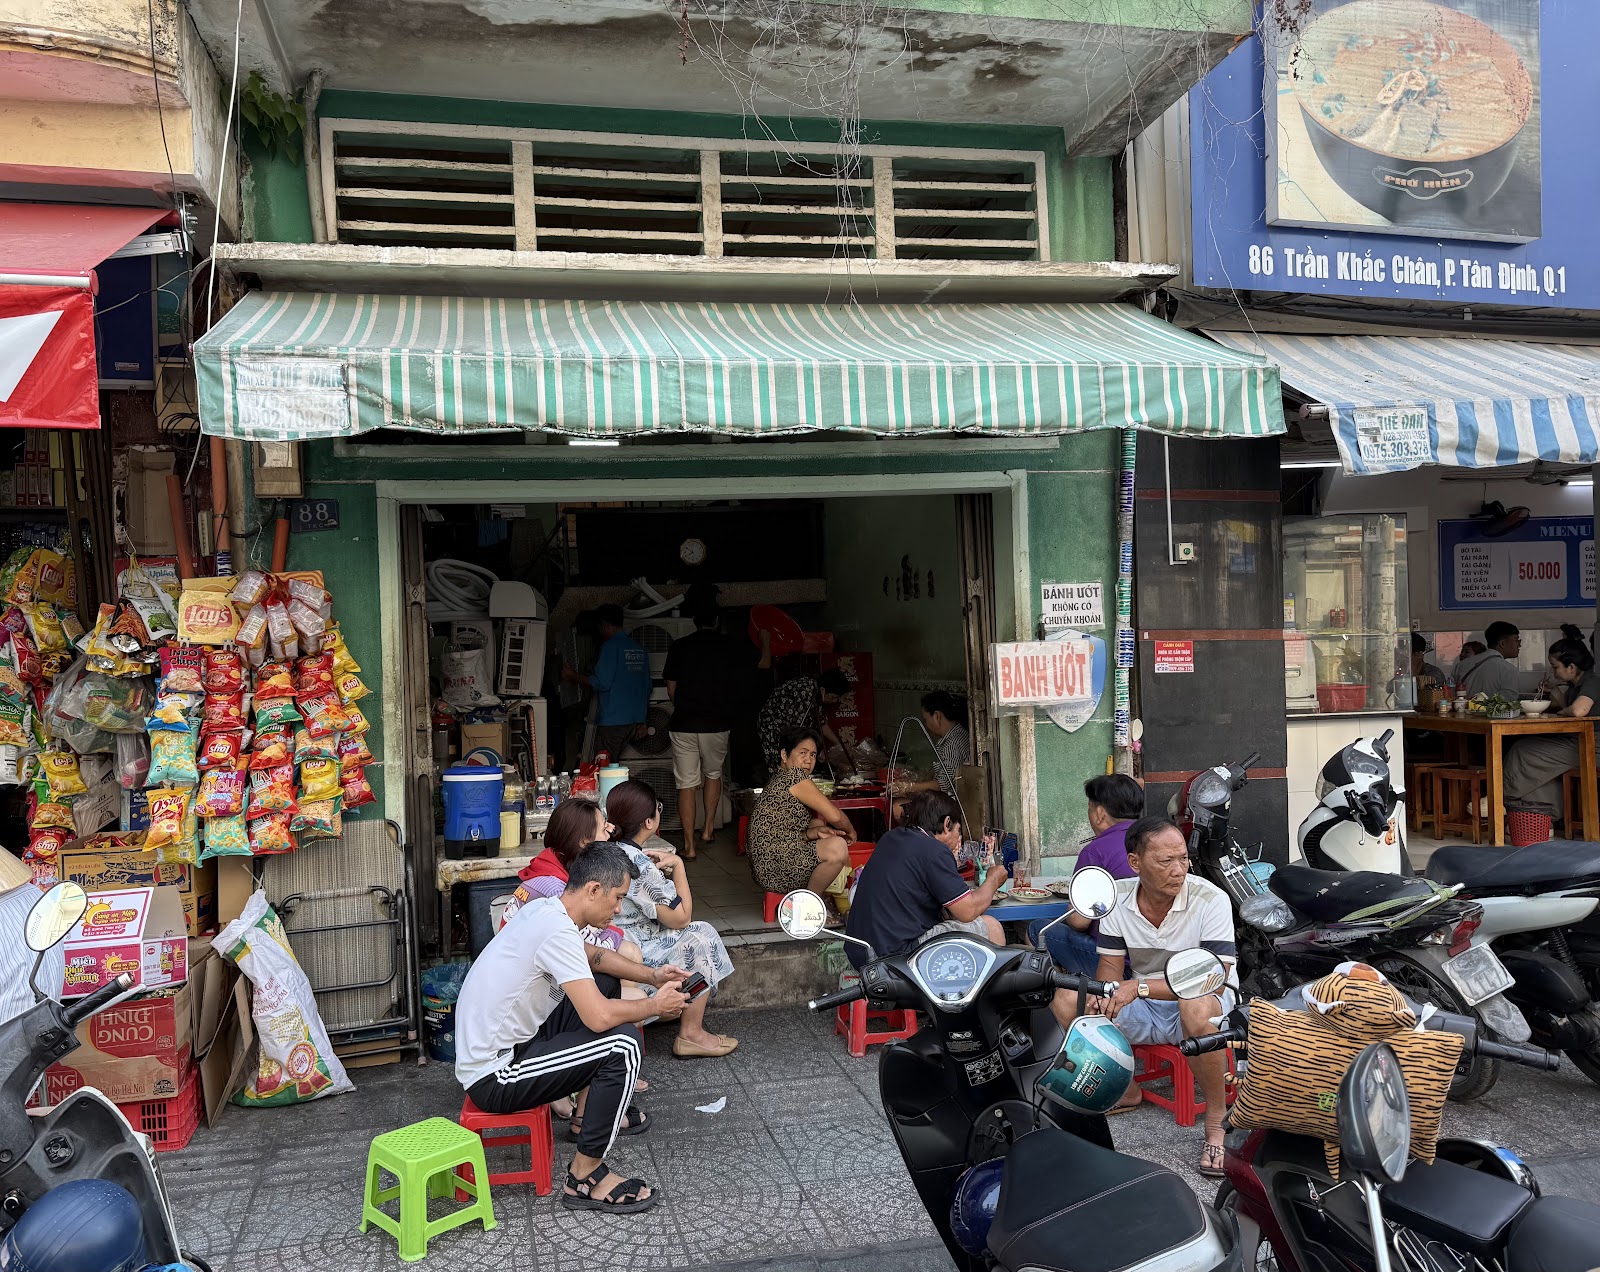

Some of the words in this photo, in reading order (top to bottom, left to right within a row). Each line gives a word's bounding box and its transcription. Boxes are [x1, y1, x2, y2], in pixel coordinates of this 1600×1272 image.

[1248, 245, 1274, 276] 86
[1283, 245, 1329, 279] Trần
[1336, 249, 1386, 283] Khắc
[1391, 254, 1441, 289] Chân,
[1444, 258, 1456, 287] P.
[1459, 259, 1493, 289] Tân
[1497, 261, 1541, 295] Định,
[1543, 265, 1566, 297] Q.1
[300, 502, 329, 522] 88
[1540, 524, 1592, 537] MENU
[1519, 561, 1561, 580] 50.000
[1043, 586, 1074, 600] BÁNH
[1077, 584, 1100, 599] ƯỚT
[1052, 600, 1079, 612] KHÔNG
[1081, 599, 1092, 611] CÓ
[185, 606, 230, 627] Lay's
[1044, 612, 1072, 626] CHUYỂN
[1074, 611, 1101, 624] KHOẢN
[168, 648, 199, 657] INDO
[169, 656, 201, 667] Chips
[1001, 643, 1049, 699] BÁNH
[1052, 641, 1086, 697] ƯỚT
[98, 1025, 154, 1044] CUNG
